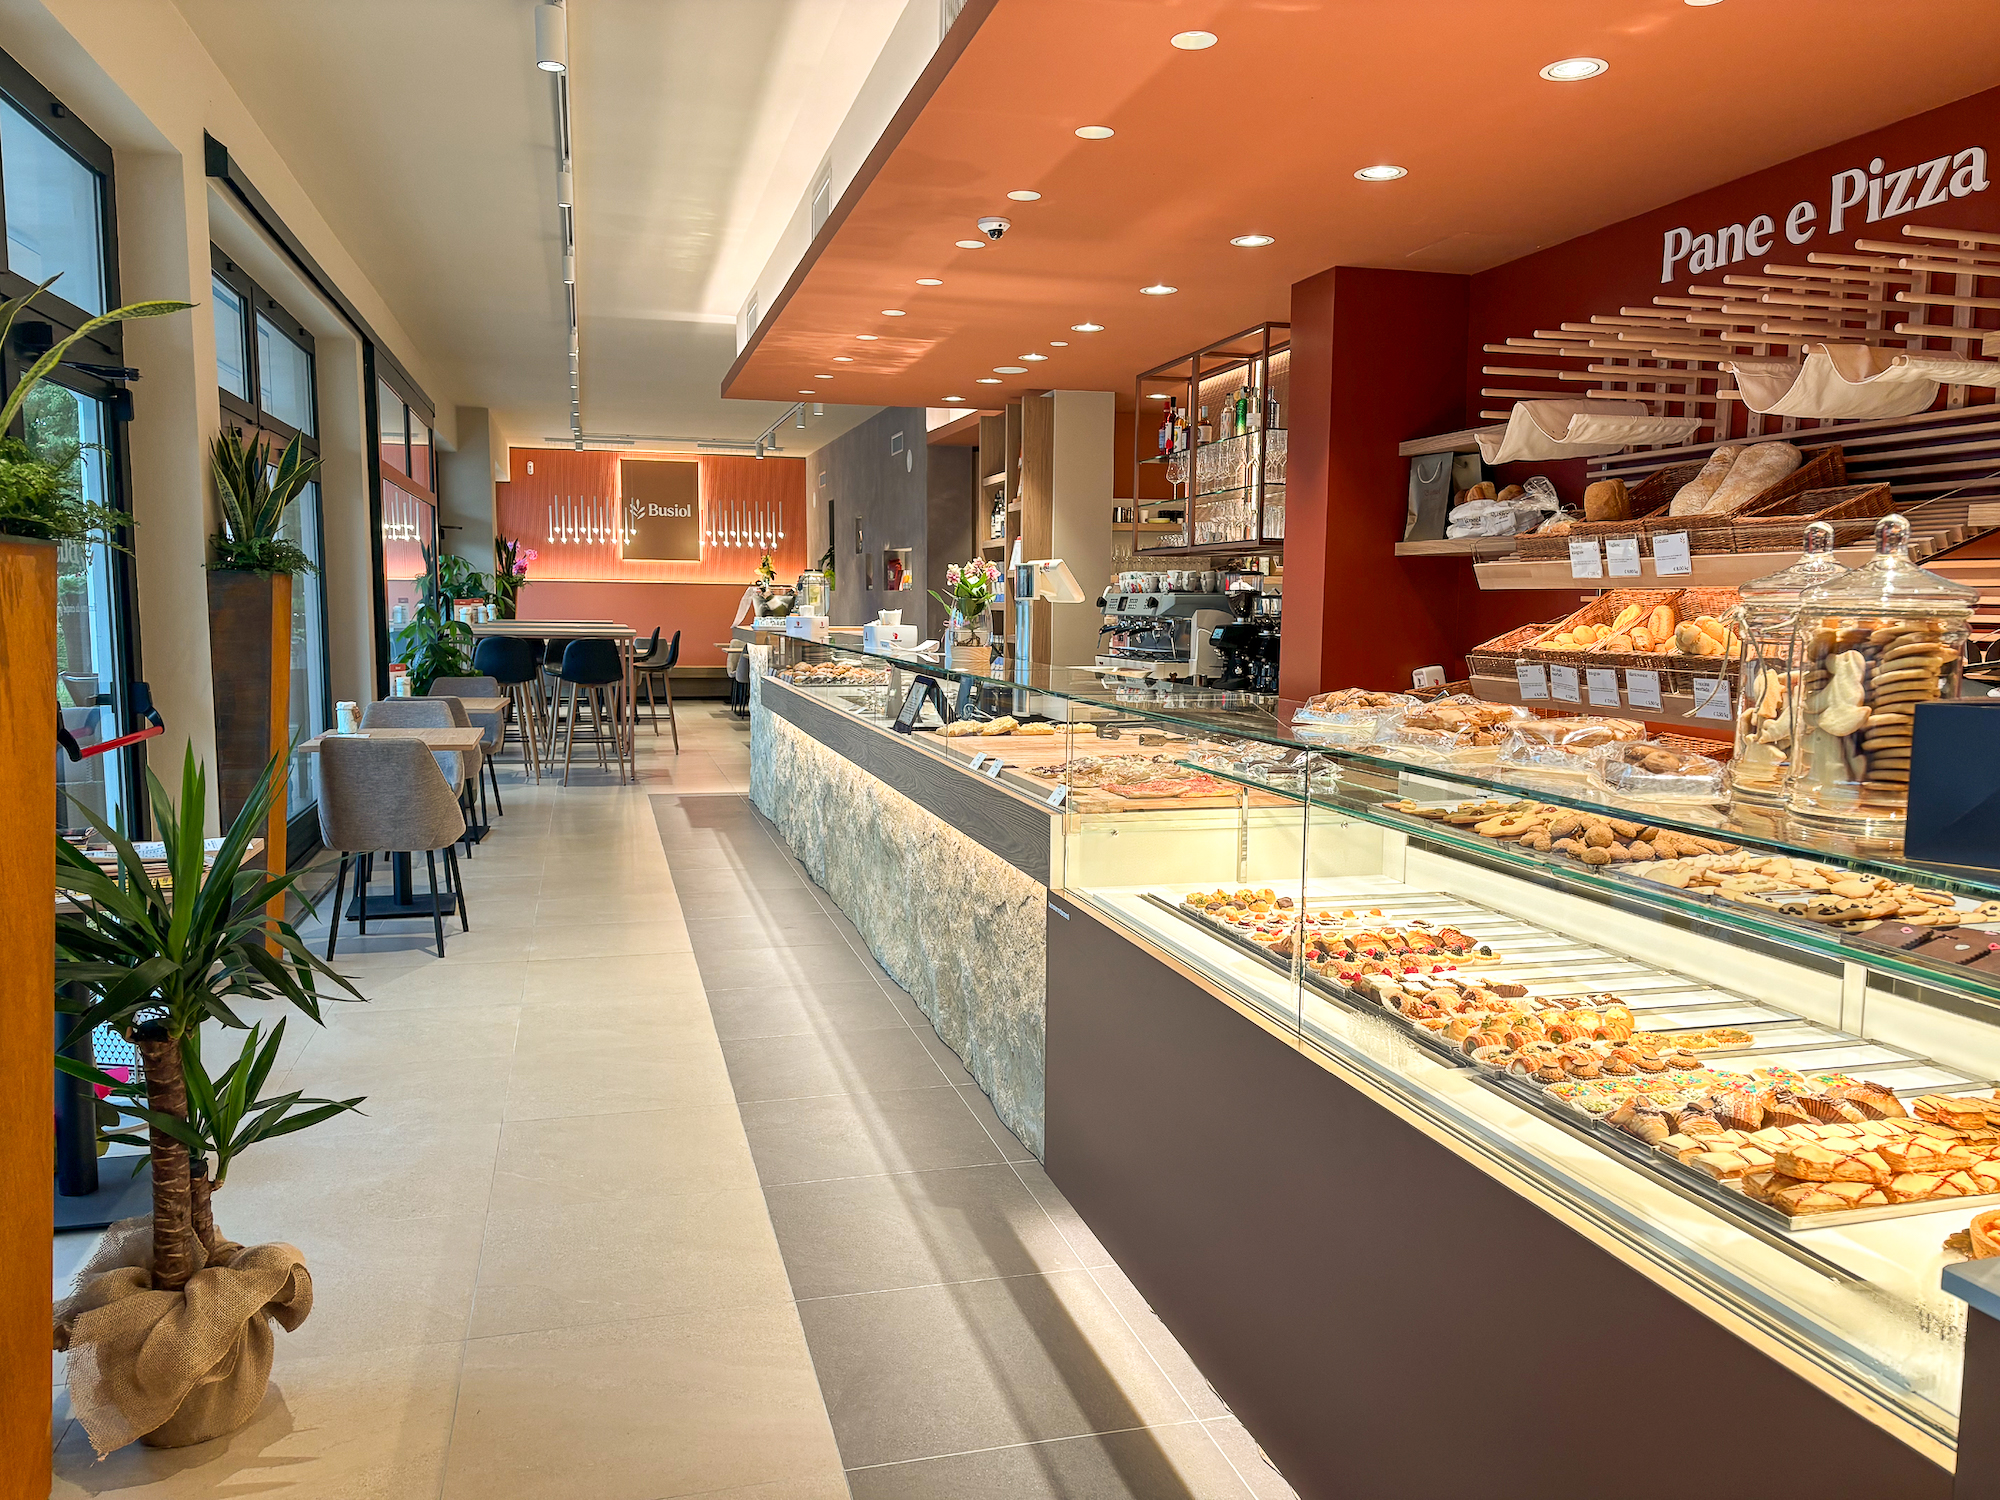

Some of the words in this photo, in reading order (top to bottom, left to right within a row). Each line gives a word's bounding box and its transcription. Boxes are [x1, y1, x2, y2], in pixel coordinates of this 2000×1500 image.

[1661, 213, 1774, 284] Pane
[1785, 200, 1817, 245] e
[1828, 145, 1990, 235] Pizza
[648, 502, 692, 518] Busiol
